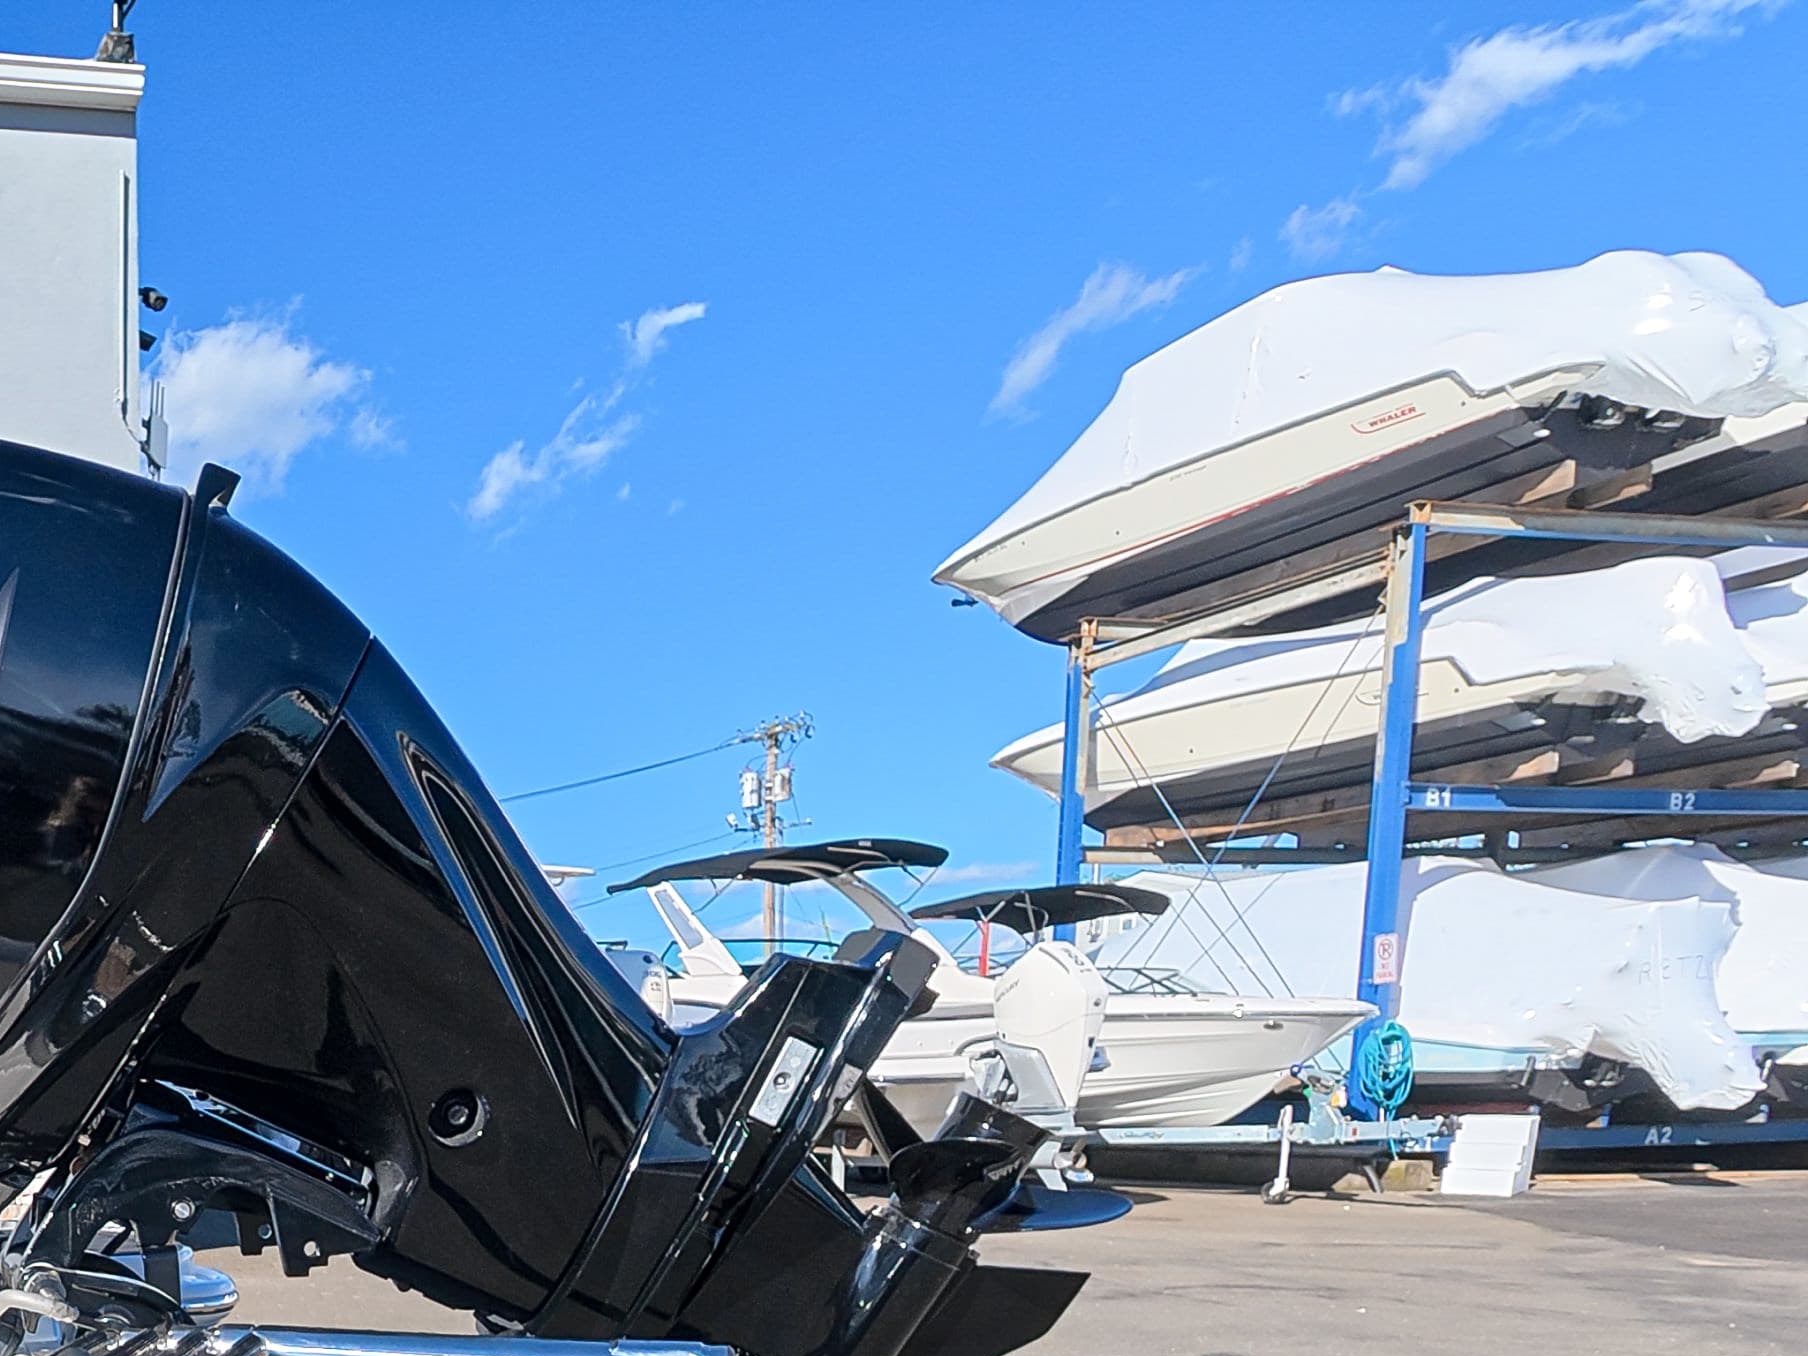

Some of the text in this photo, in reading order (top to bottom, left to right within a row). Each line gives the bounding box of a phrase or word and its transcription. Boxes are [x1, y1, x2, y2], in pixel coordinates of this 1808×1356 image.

[1368, 406, 1416, 427] WHALER
[1425, 787, 1452, 808] B1
[1670, 793, 1696, 811] B2
[1644, 1126, 1672, 1145] A2
